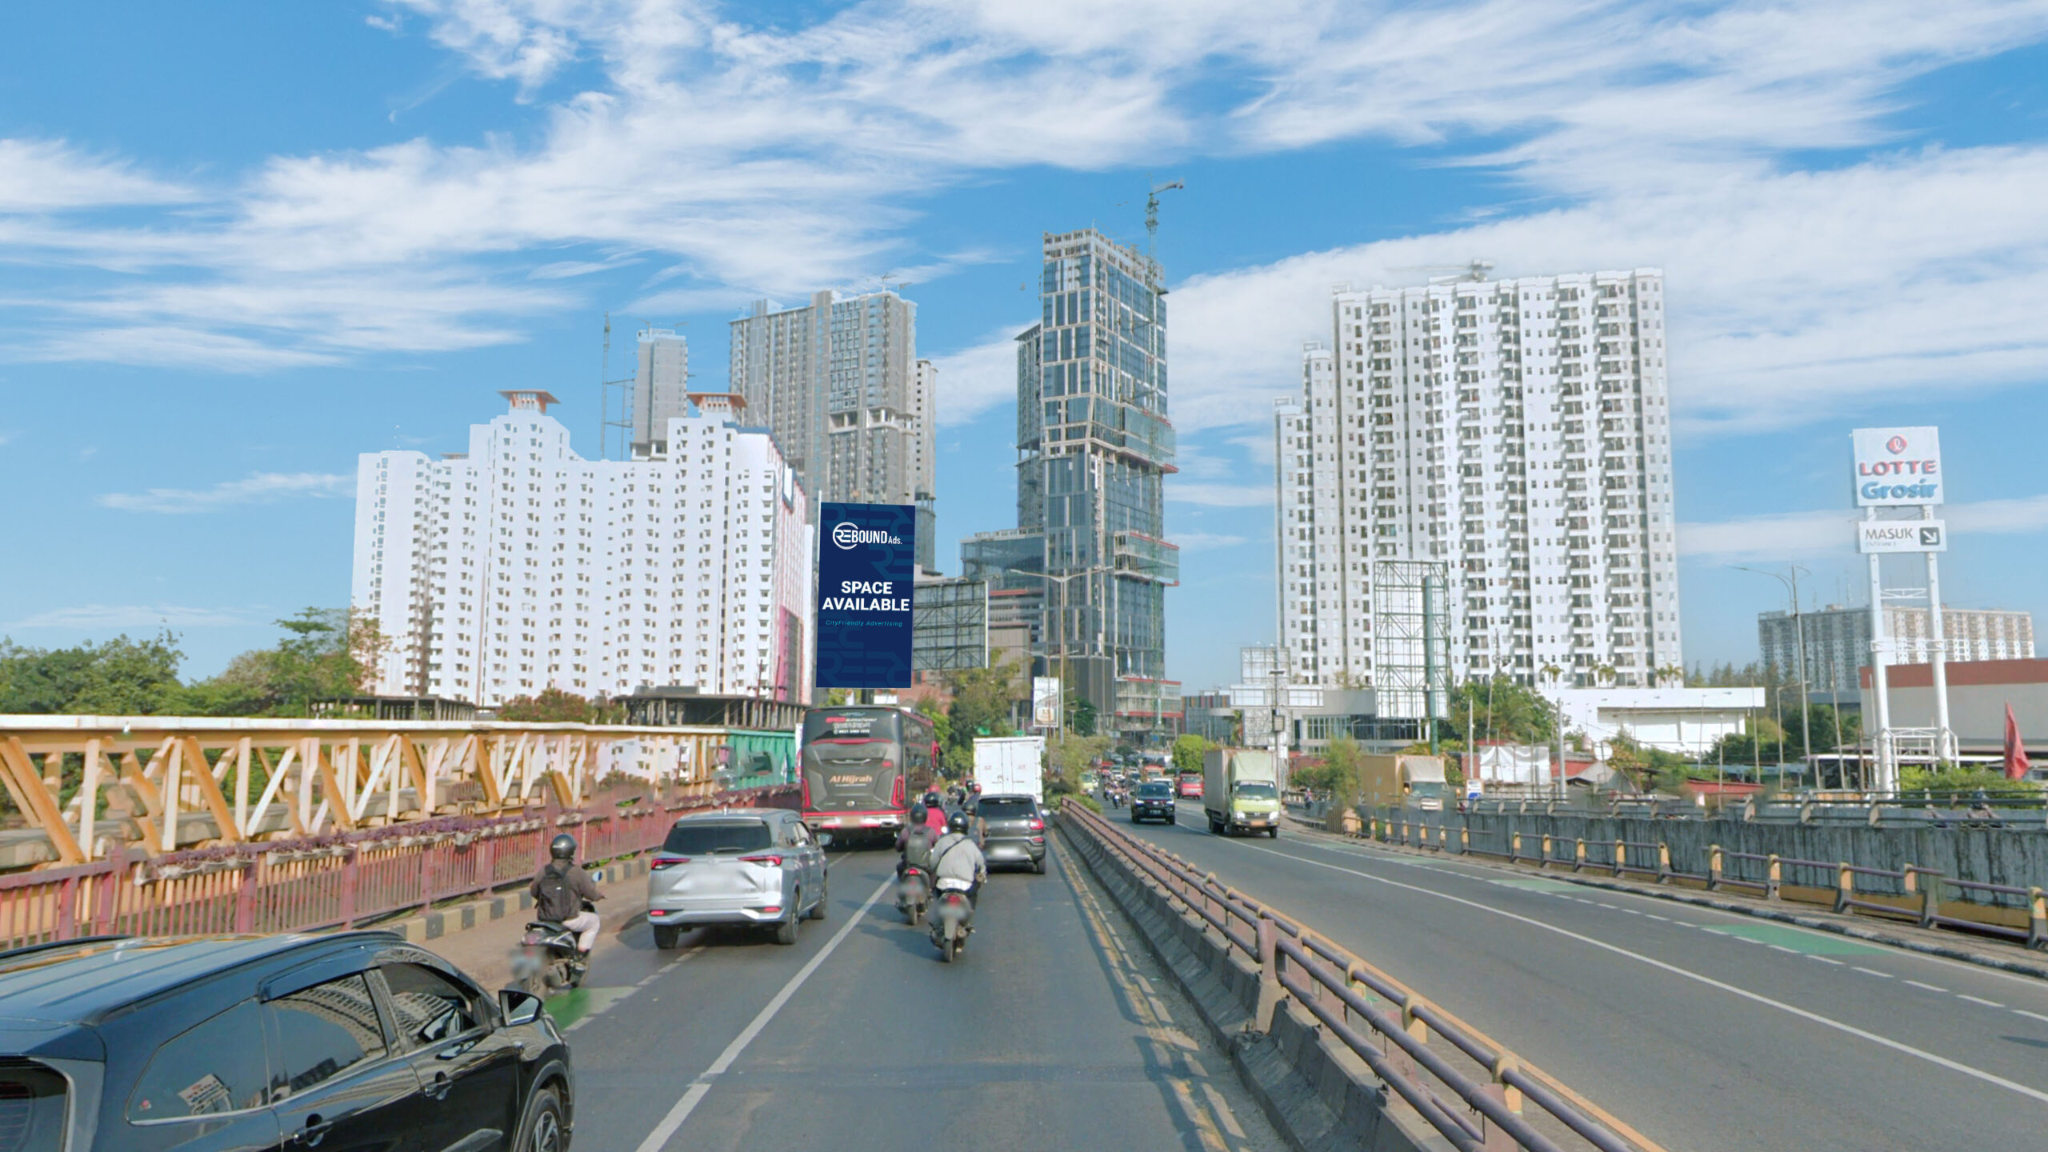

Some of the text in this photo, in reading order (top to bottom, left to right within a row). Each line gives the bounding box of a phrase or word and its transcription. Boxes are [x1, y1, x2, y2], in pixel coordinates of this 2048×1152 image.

[1859, 460, 1937, 476] LOTTE
[1861, 479, 1938, 499] Grosir
[1865, 528, 1914, 540] MASUK
[841, 581, 893, 595] SPACE
[822, 597, 910, 611] AVAILABLE
[866, 620, 903, 628] Advertising
[829, 775, 872, 784] Al Hijrah
